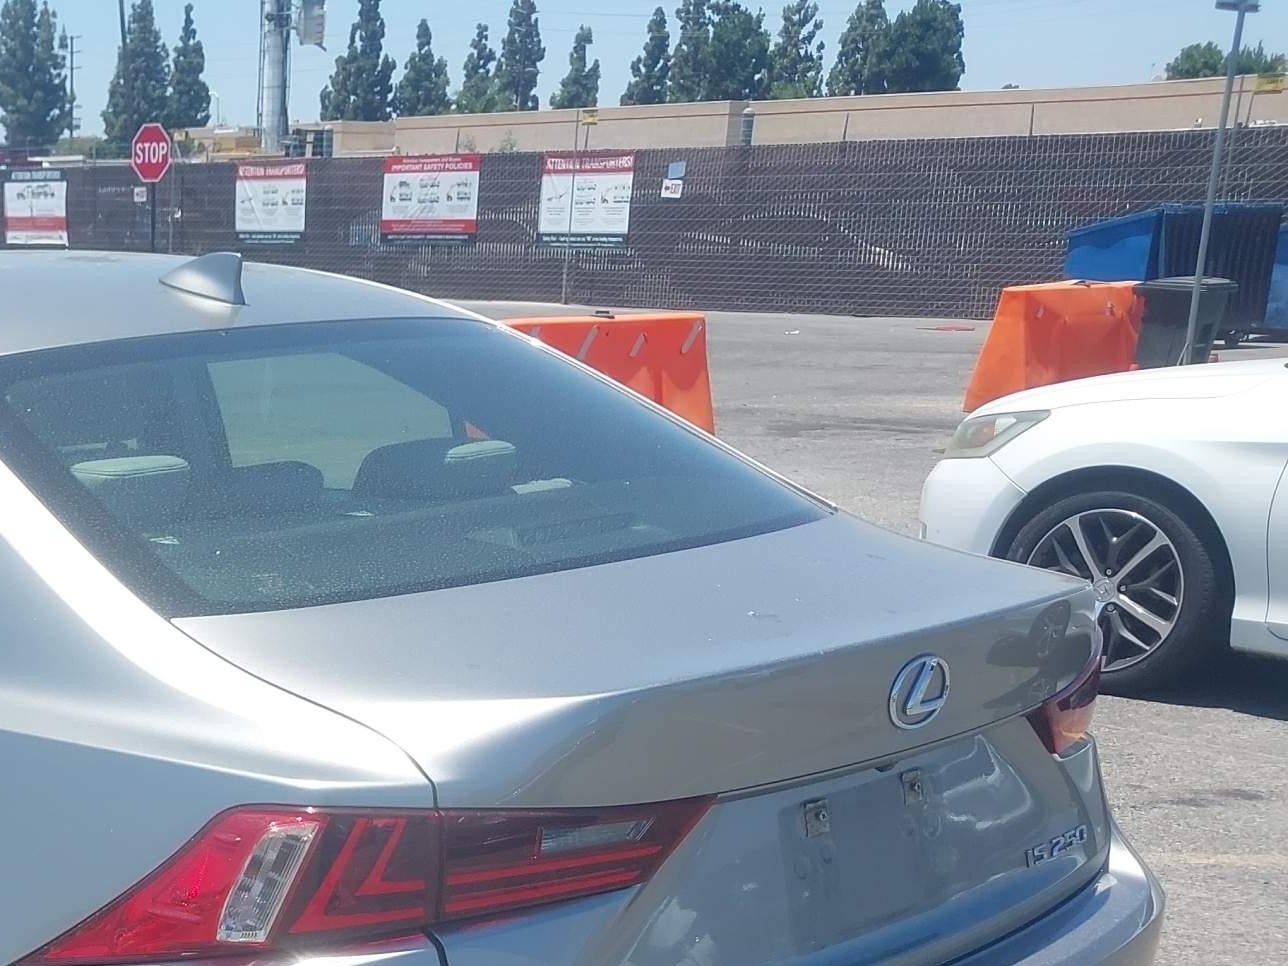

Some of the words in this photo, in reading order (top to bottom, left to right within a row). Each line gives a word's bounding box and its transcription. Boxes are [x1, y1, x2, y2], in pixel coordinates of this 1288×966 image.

[135, 143, 168, 164] STOP
[391, 164, 422, 172] IMPORTANT
[423, 163, 444, 171] SAFETY
[445, 162, 473, 170] POLICIES
[546, 158, 580, 170] ATTENTIN
[1024, 844, 1049, 868] IS
[1050, 825, 1088, 857] 250
